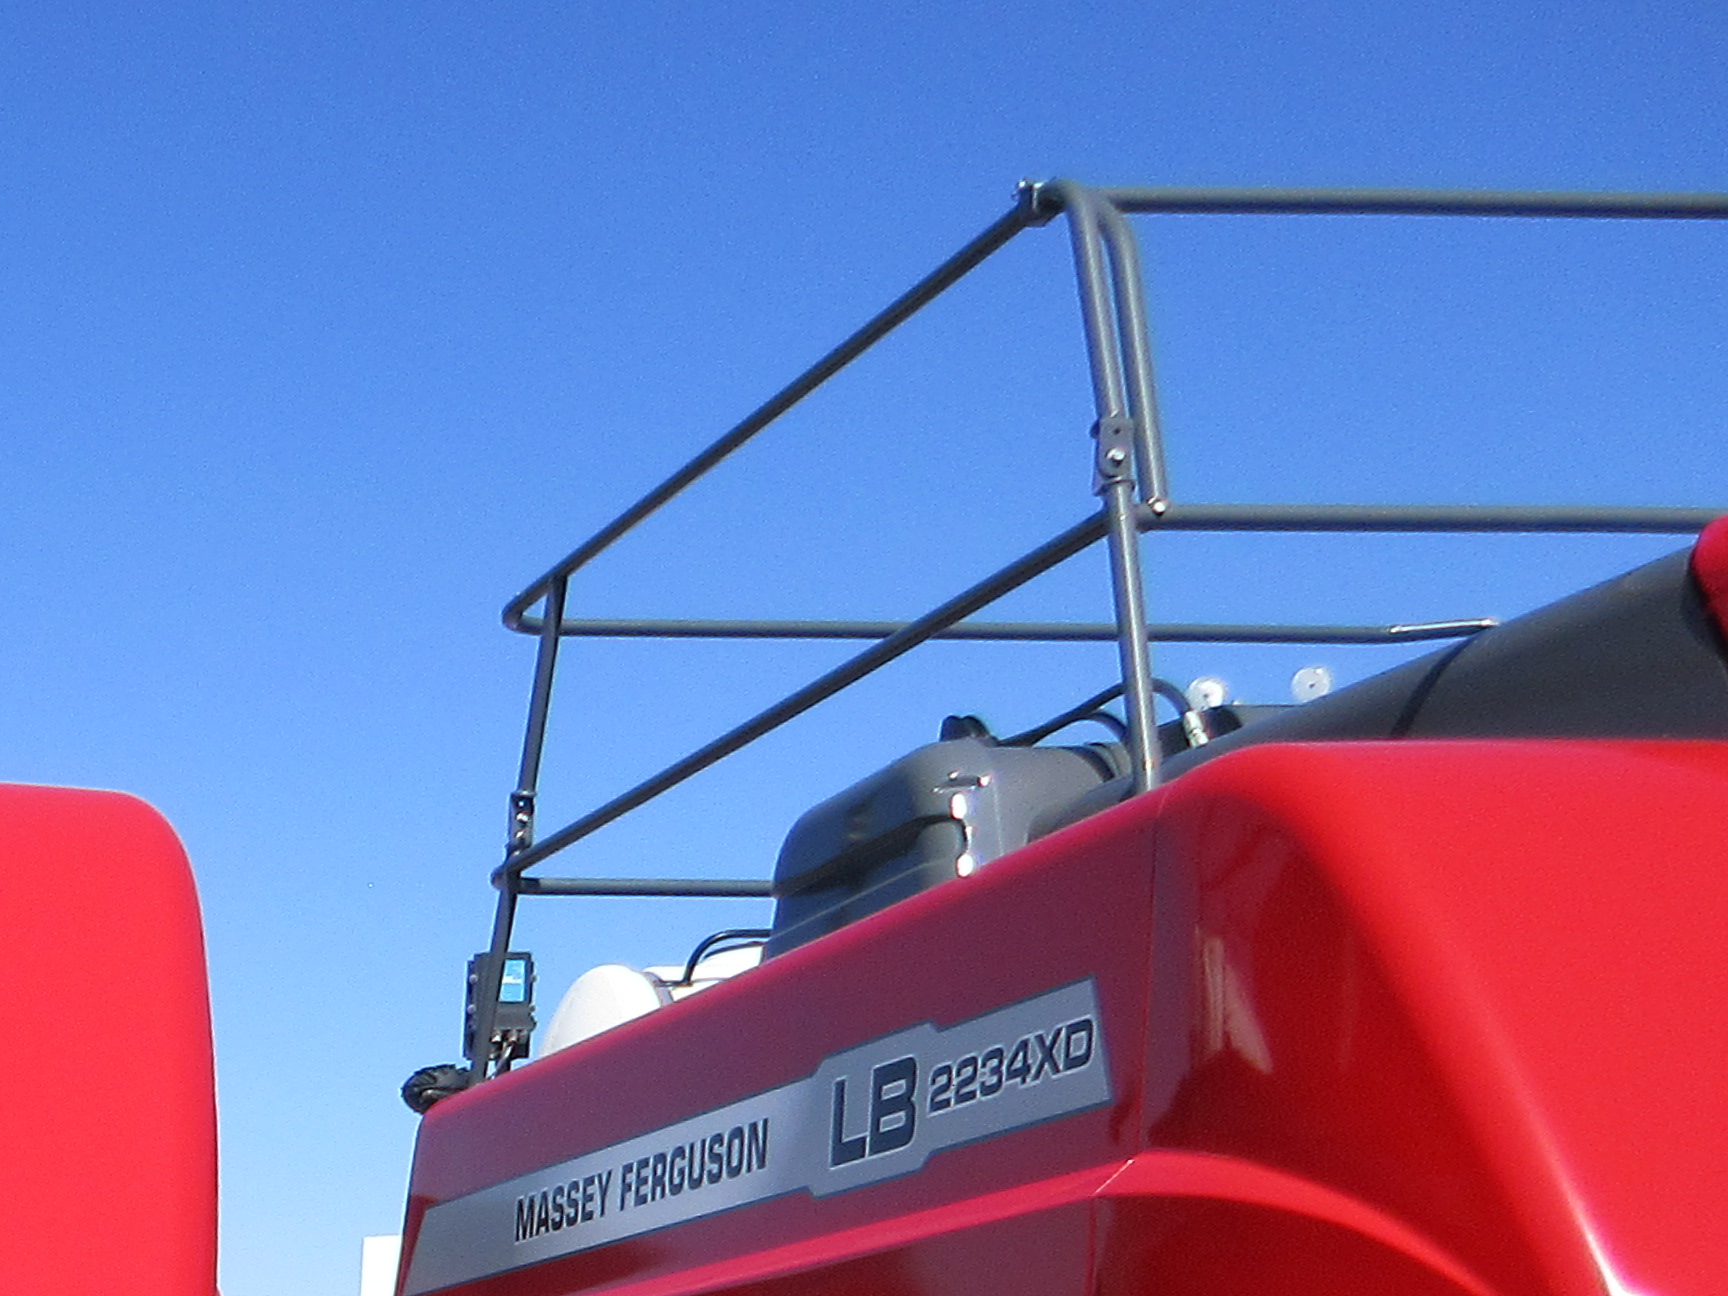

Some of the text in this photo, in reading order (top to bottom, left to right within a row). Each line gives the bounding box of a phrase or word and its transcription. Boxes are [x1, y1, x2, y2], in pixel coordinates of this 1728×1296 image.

[829, 1014, 1095, 1170] LB 2234XD
[514, 1118, 769, 1243] MASSEY FERGUSON
